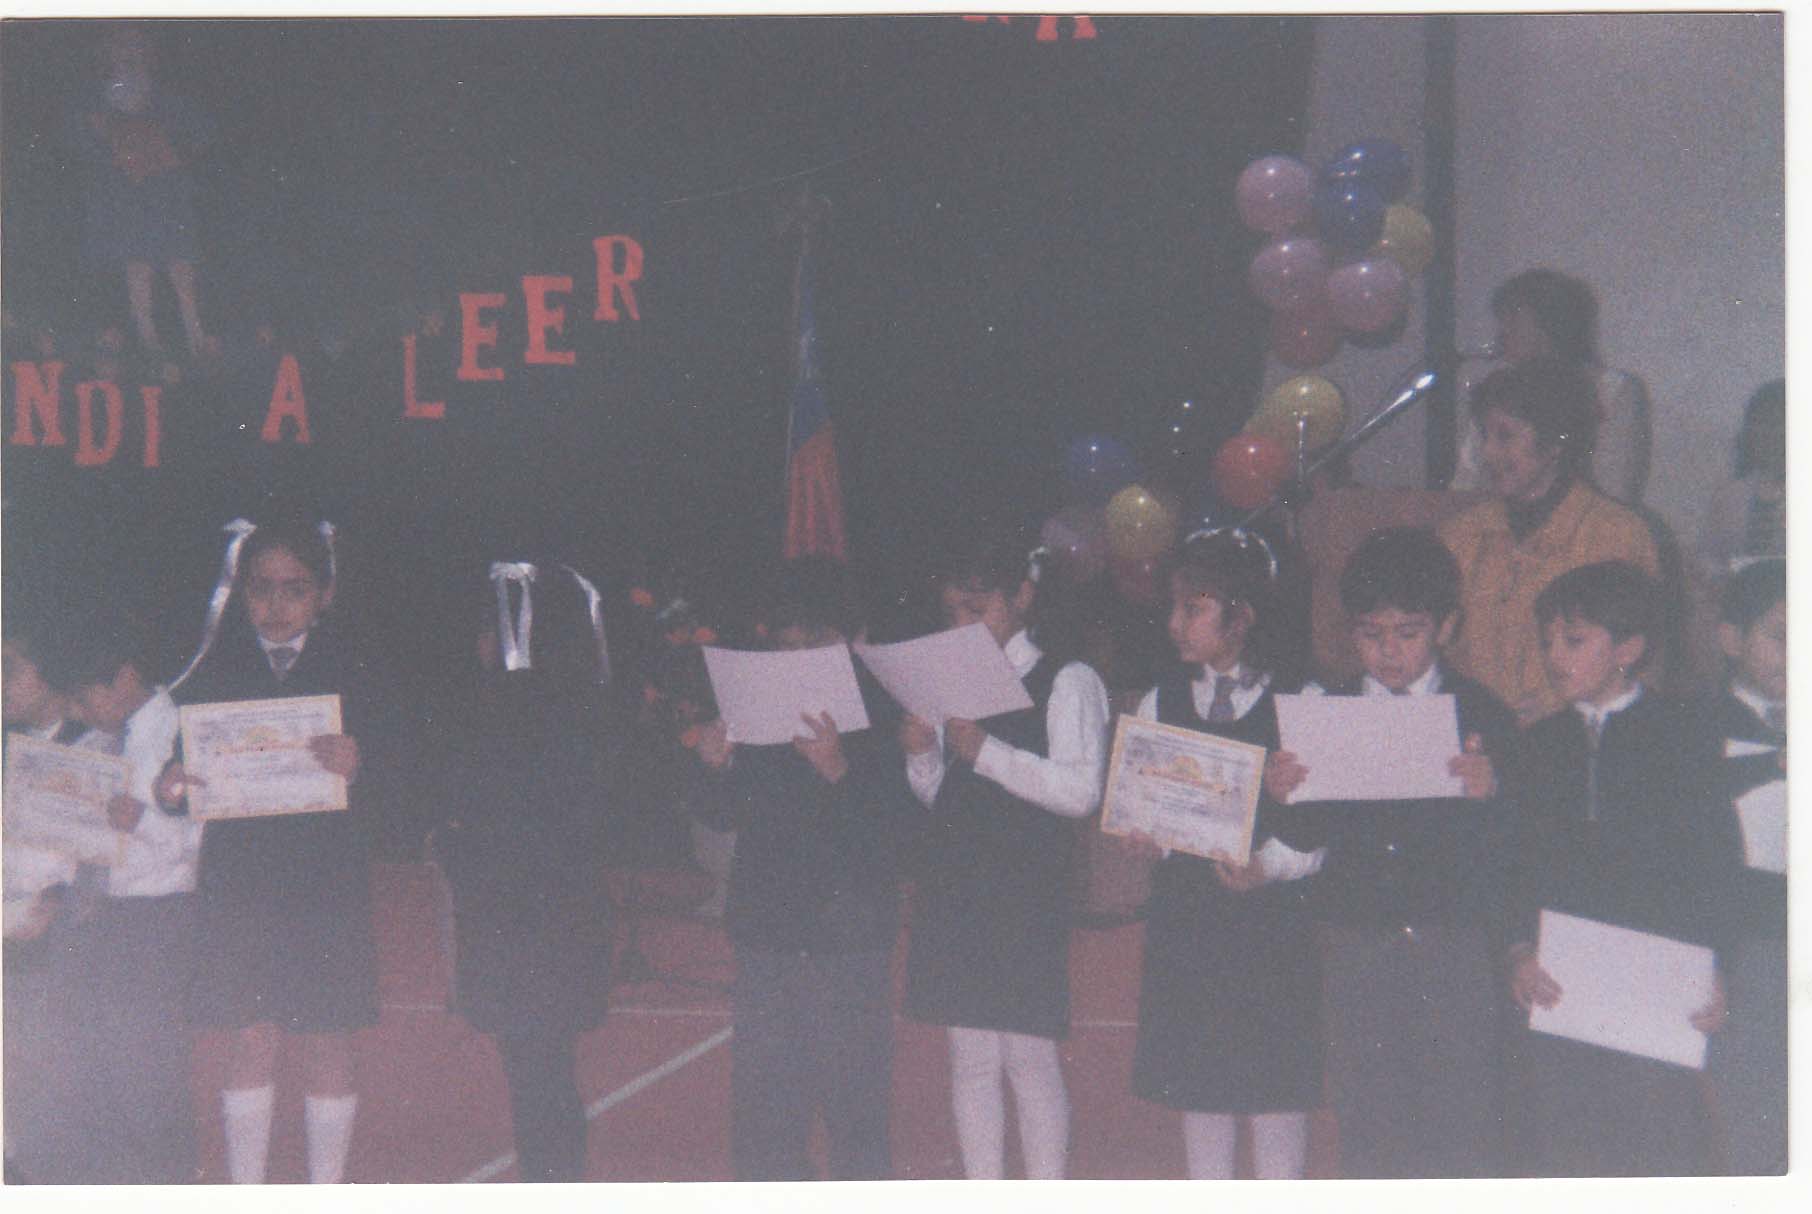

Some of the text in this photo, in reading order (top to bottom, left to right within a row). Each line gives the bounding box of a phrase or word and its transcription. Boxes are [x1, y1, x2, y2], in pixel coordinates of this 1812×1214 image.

[11, 235, 644, 467] NDI A LEER
